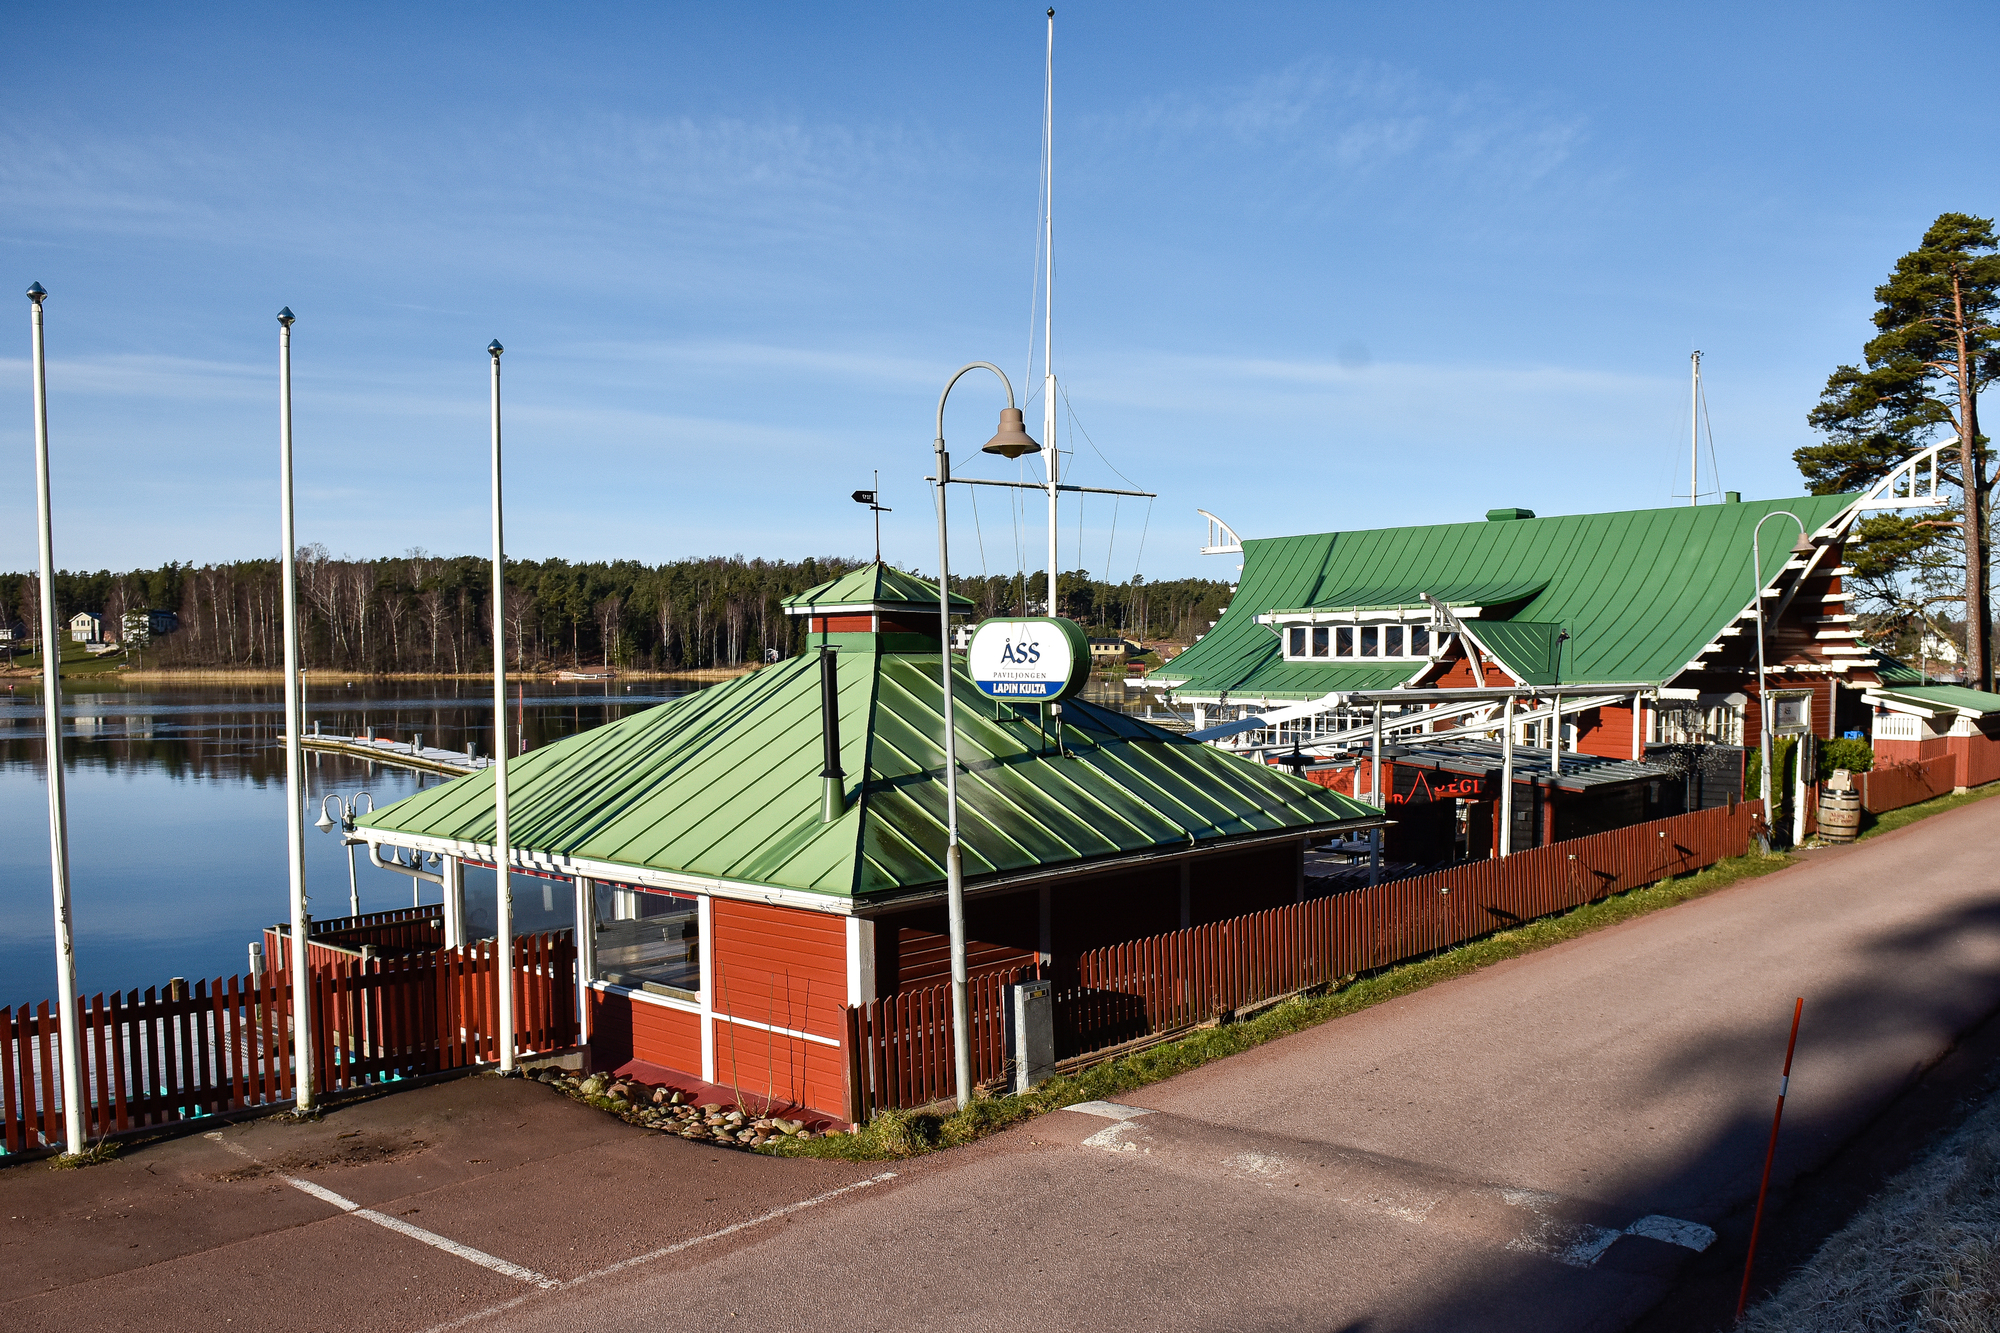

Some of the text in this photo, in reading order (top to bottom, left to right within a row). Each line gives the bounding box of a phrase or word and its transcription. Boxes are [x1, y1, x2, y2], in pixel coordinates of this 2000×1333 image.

[1000, 637, 1041, 664] ÅSS
[993, 671, 1047, 680] PAVILJONGEN
[992, 683, 1047, 694] LAPIN KULTA
